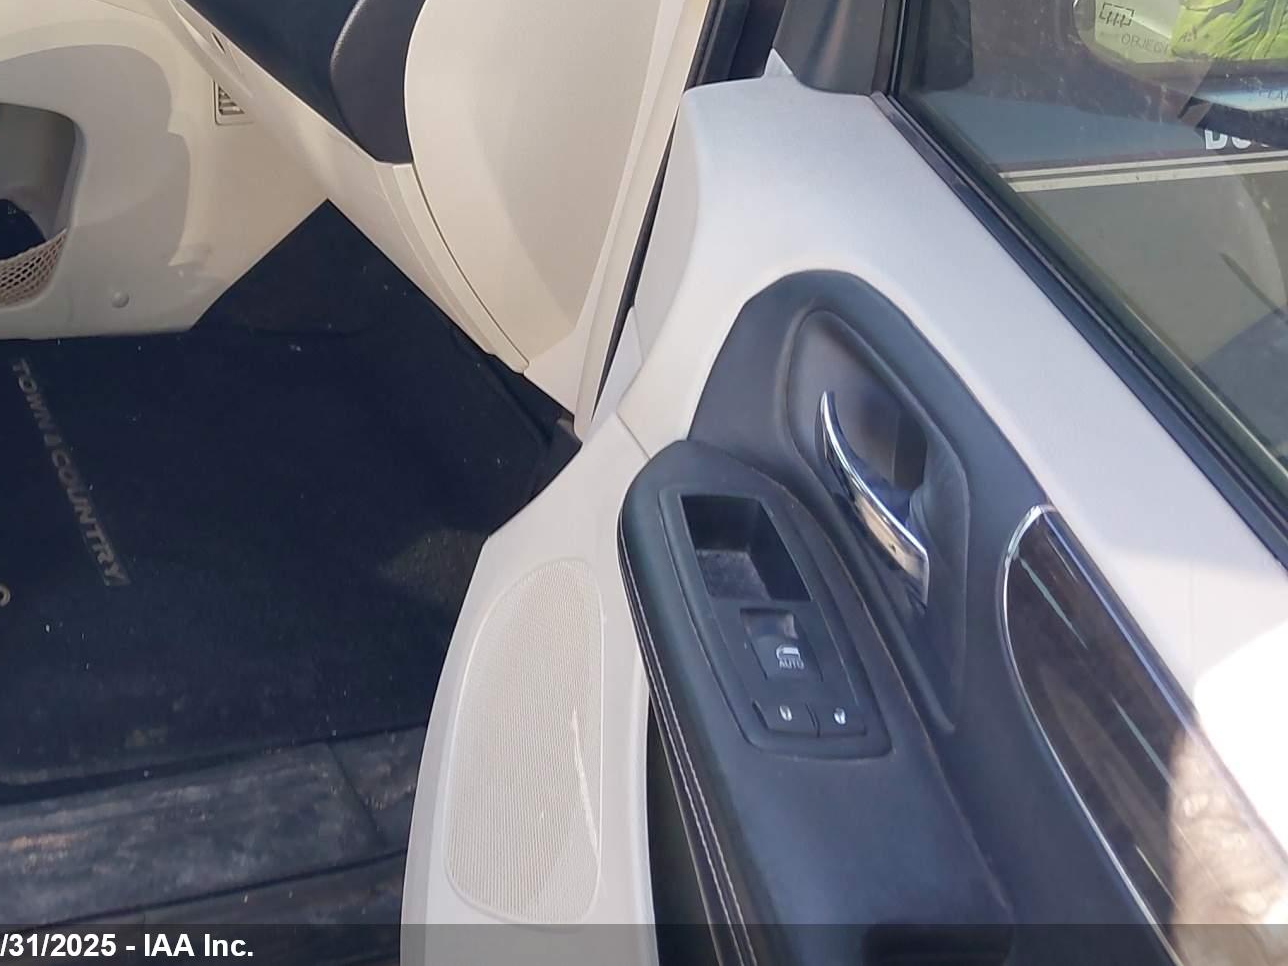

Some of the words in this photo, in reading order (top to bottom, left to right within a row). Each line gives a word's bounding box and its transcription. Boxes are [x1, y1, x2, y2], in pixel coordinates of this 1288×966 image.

[12, 358, 55, 430] TOWN
[52, 448, 129, 584] COUNTRY
[779, 657, 805, 670] AUTO
